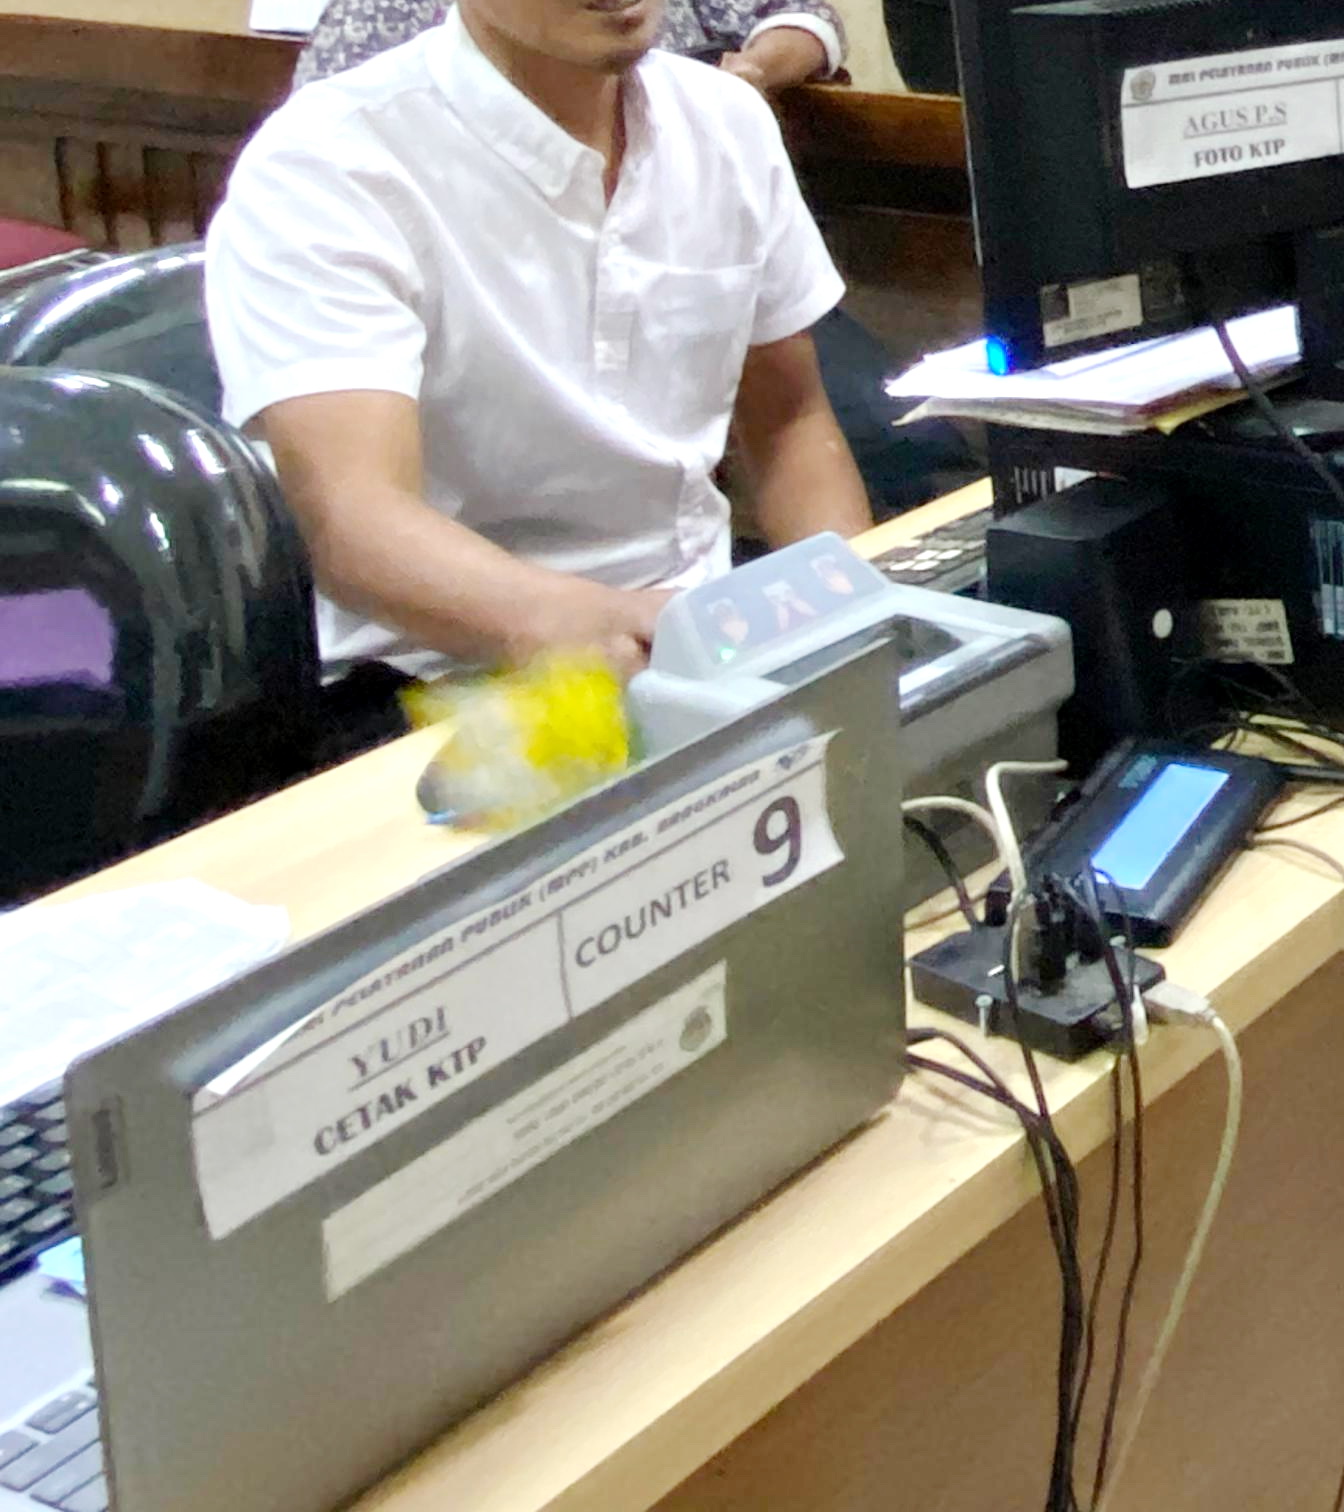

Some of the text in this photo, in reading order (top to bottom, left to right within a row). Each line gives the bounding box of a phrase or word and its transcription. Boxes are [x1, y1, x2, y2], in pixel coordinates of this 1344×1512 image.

[1184, 105, 1248, 137] AGUS
[1194, 138, 1286, 169] FOTO KTP
[575, 794, 803, 969] COUNTER 9
[348, 1006, 448, 1078] YUDI
[313, 1072, 420, 1158] CETAK
[425, 1035, 490, 1093] KTP
